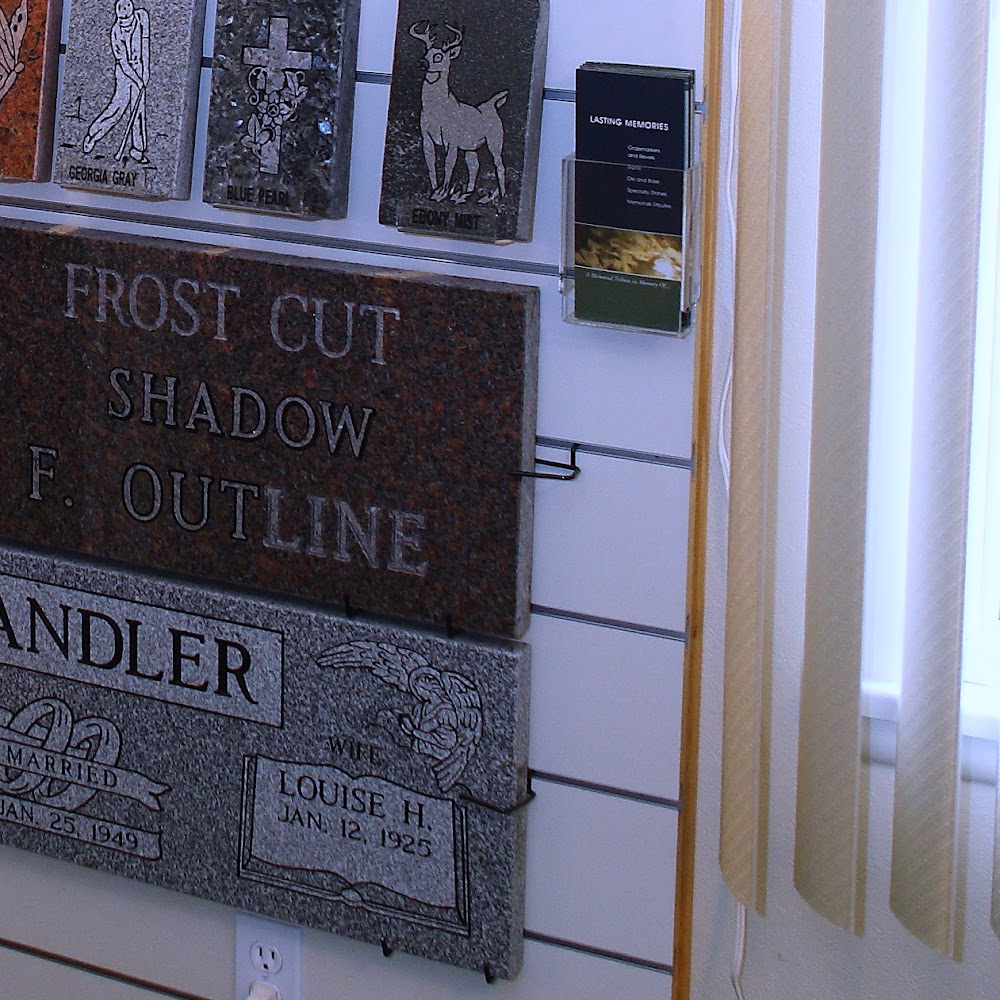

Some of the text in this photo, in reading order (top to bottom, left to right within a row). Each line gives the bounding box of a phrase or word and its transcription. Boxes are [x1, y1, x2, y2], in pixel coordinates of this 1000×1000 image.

[589, 115, 669, 131] LASTING MEMORIES
[69, 165, 138, 187] GEORGIA GRAY
[227, 185, 254, 202] BLUE
[64, 263, 400, 365] FROST CUT
[107, 367, 375, 458] SHADOW
[28, 444, 430, 577] F. OUTLINE
[7, 745, 118, 787] MARRIED
[328, 736, 381, 764] WIFE
[279, 770, 432, 831] LOUISE H.
[92, 824, 138, 849] 1949
[278, 804, 432, 857] JAN. 12, 1925
